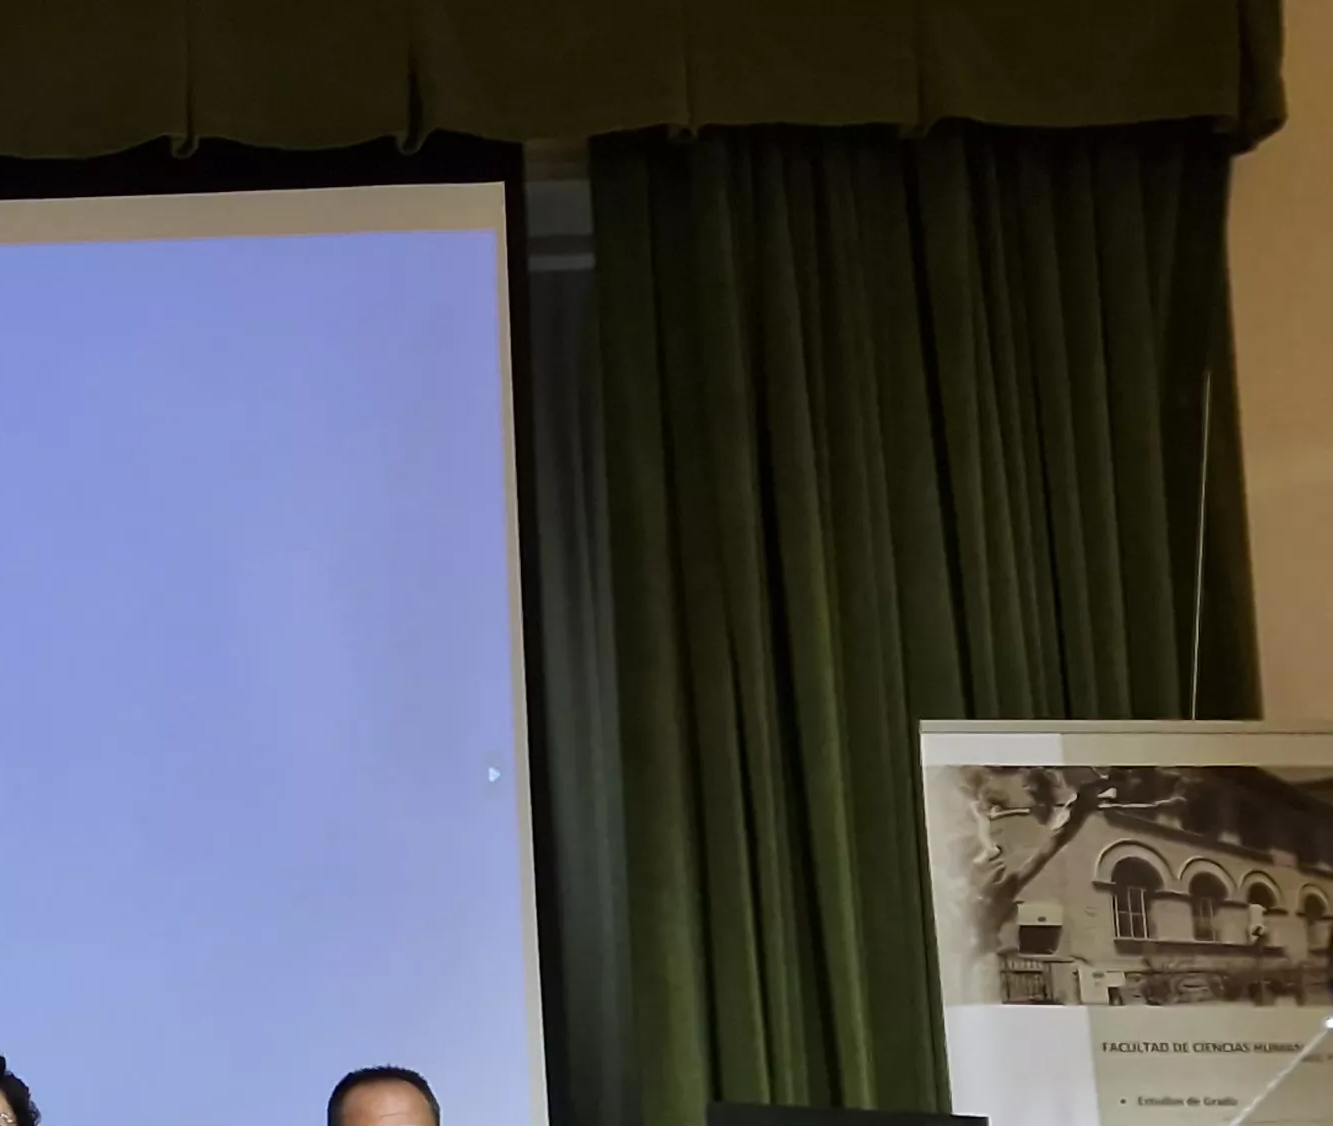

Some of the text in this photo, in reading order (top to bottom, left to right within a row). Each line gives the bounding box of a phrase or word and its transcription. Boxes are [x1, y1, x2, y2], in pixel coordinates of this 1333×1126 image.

[1102, 1041, 1169, 1054] FACULTAD
[1173, 1041, 1190, 1054] DE
[1193, 1041, 1251, 1054] CIENCIAS
